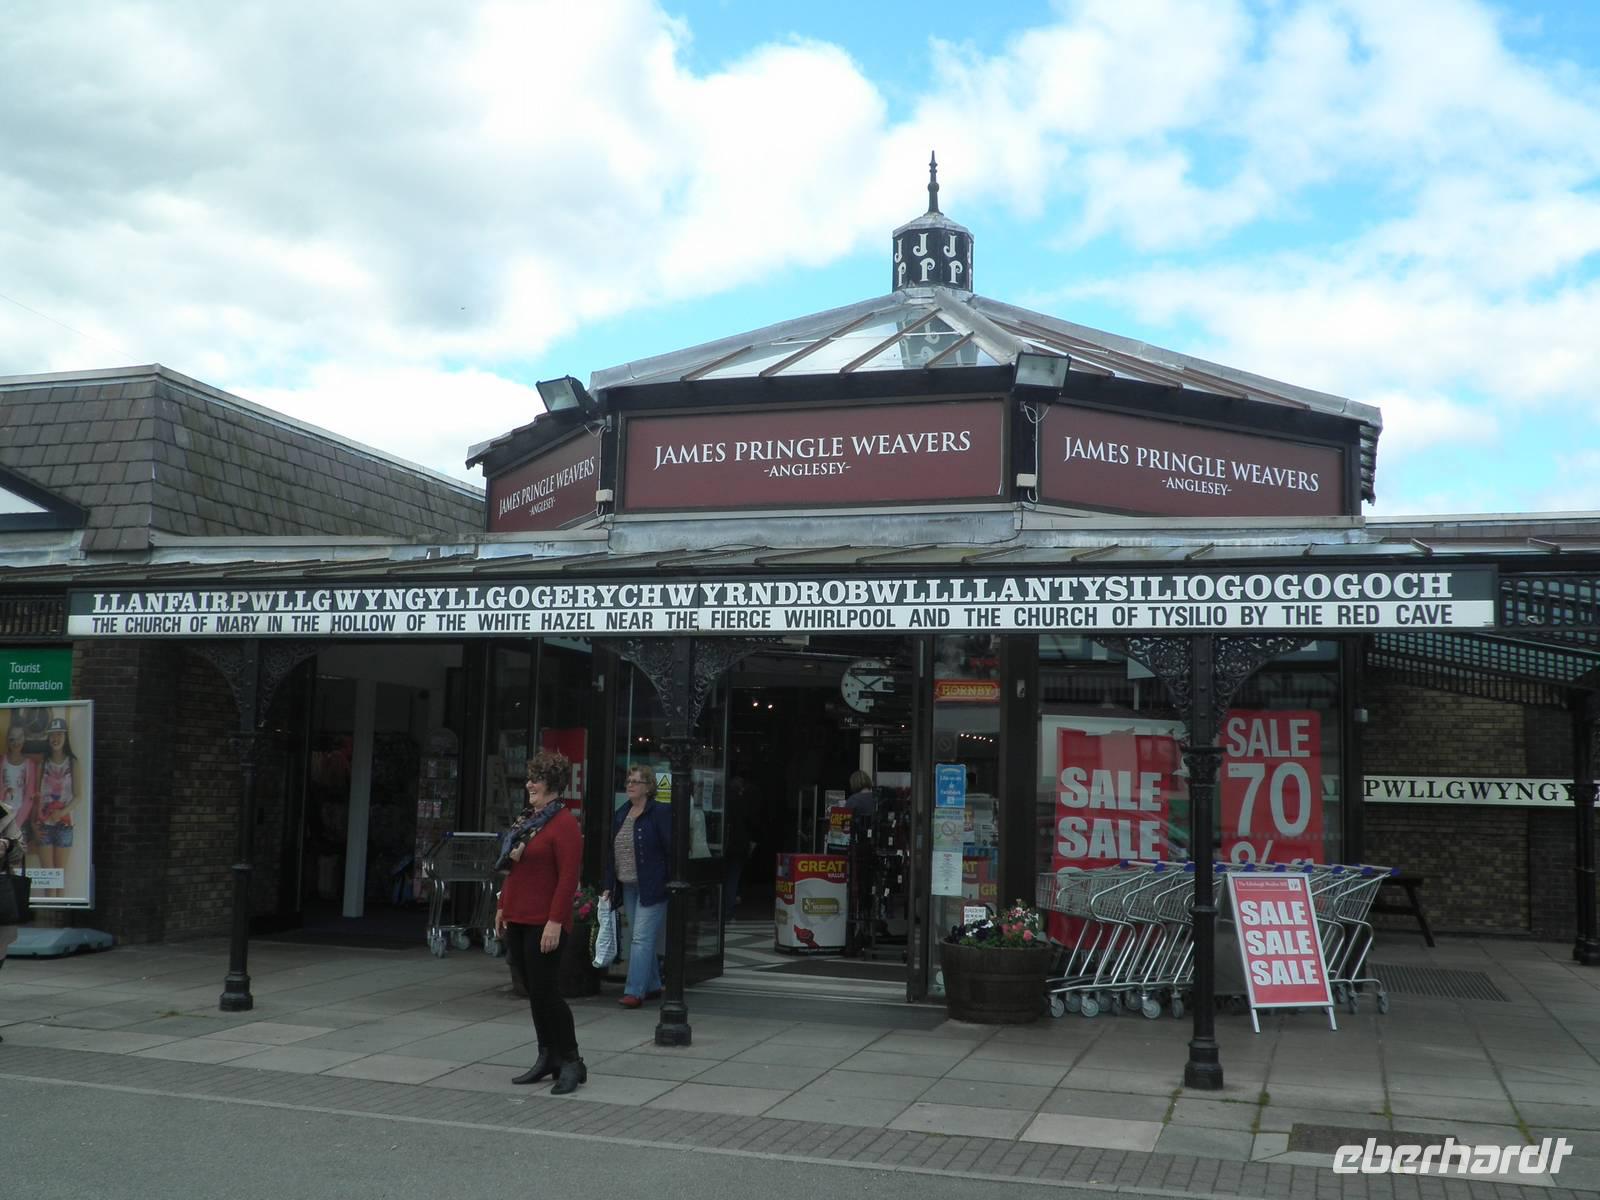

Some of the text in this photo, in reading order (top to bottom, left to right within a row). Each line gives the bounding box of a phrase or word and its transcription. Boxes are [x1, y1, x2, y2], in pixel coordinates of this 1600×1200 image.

[913, 233, 929, 257] J
[943, 235, 957, 258] J
[919, 257, 936, 282] P
[949, 260, 963, 284] P
[654, 430, 971, 470] JAMES PRINGLE WEAVERS
[1064, 436, 1319, 492] JAMES PRINGLE WEAVERS
[498, 456, 595, 519] JAMES PRINGLE WEAVERS
[92, 572, 1453, 613] LLANFAIRPWLLGWYNGYLLGOGERYCHWYRNDROBWLLLLANTYSILIOGOGOGOCH
[92, 604, 1453, 634] THE CHURCH OF MARY IN THE HOLLOW OF THE WHITE HAZEL NEAR THE FIERCE WHIRLPOOL AND THE CHURCH OF TYSILIO BY THE RED CAVE
[9, 662, 41, 674] Tourist
[8, 679, 63, 691] Information
[1226, 717, 1310, 757] SALE
[1060, 767, 1162, 811] SALE
[1228, 762, 1311, 838] 70
[1057, 816, 1161, 860] SALE
[798, 860, 845, 873] GREAT
[1240, 900, 1307, 926] SALE
[1246, 930, 1314, 956] SALE
[1251, 960, 1320, 986] SALE
